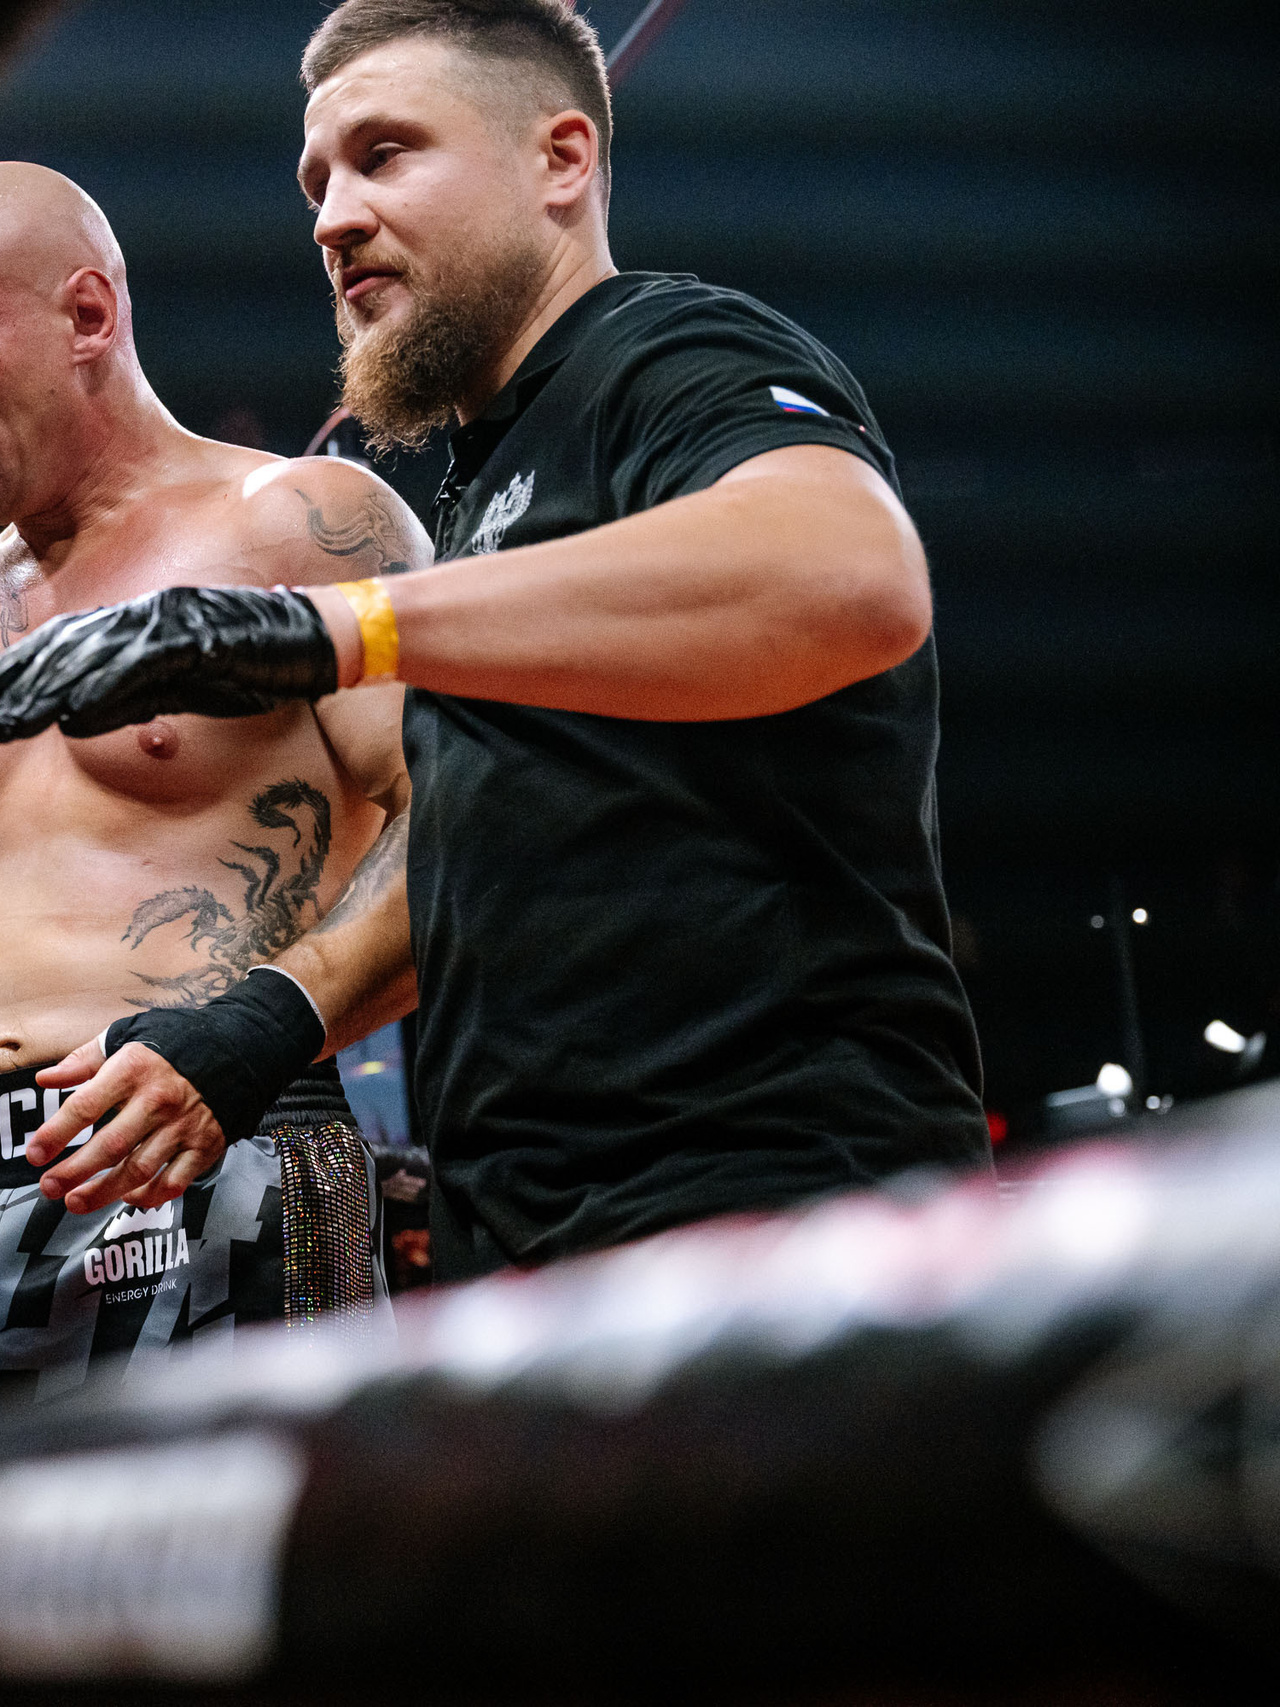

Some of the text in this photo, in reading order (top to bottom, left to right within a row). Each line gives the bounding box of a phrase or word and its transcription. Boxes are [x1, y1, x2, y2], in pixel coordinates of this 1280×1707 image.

[84, 1227, 190, 1286] GORILLA
[105, 1278, 178, 1305] ENERGY DRINK
